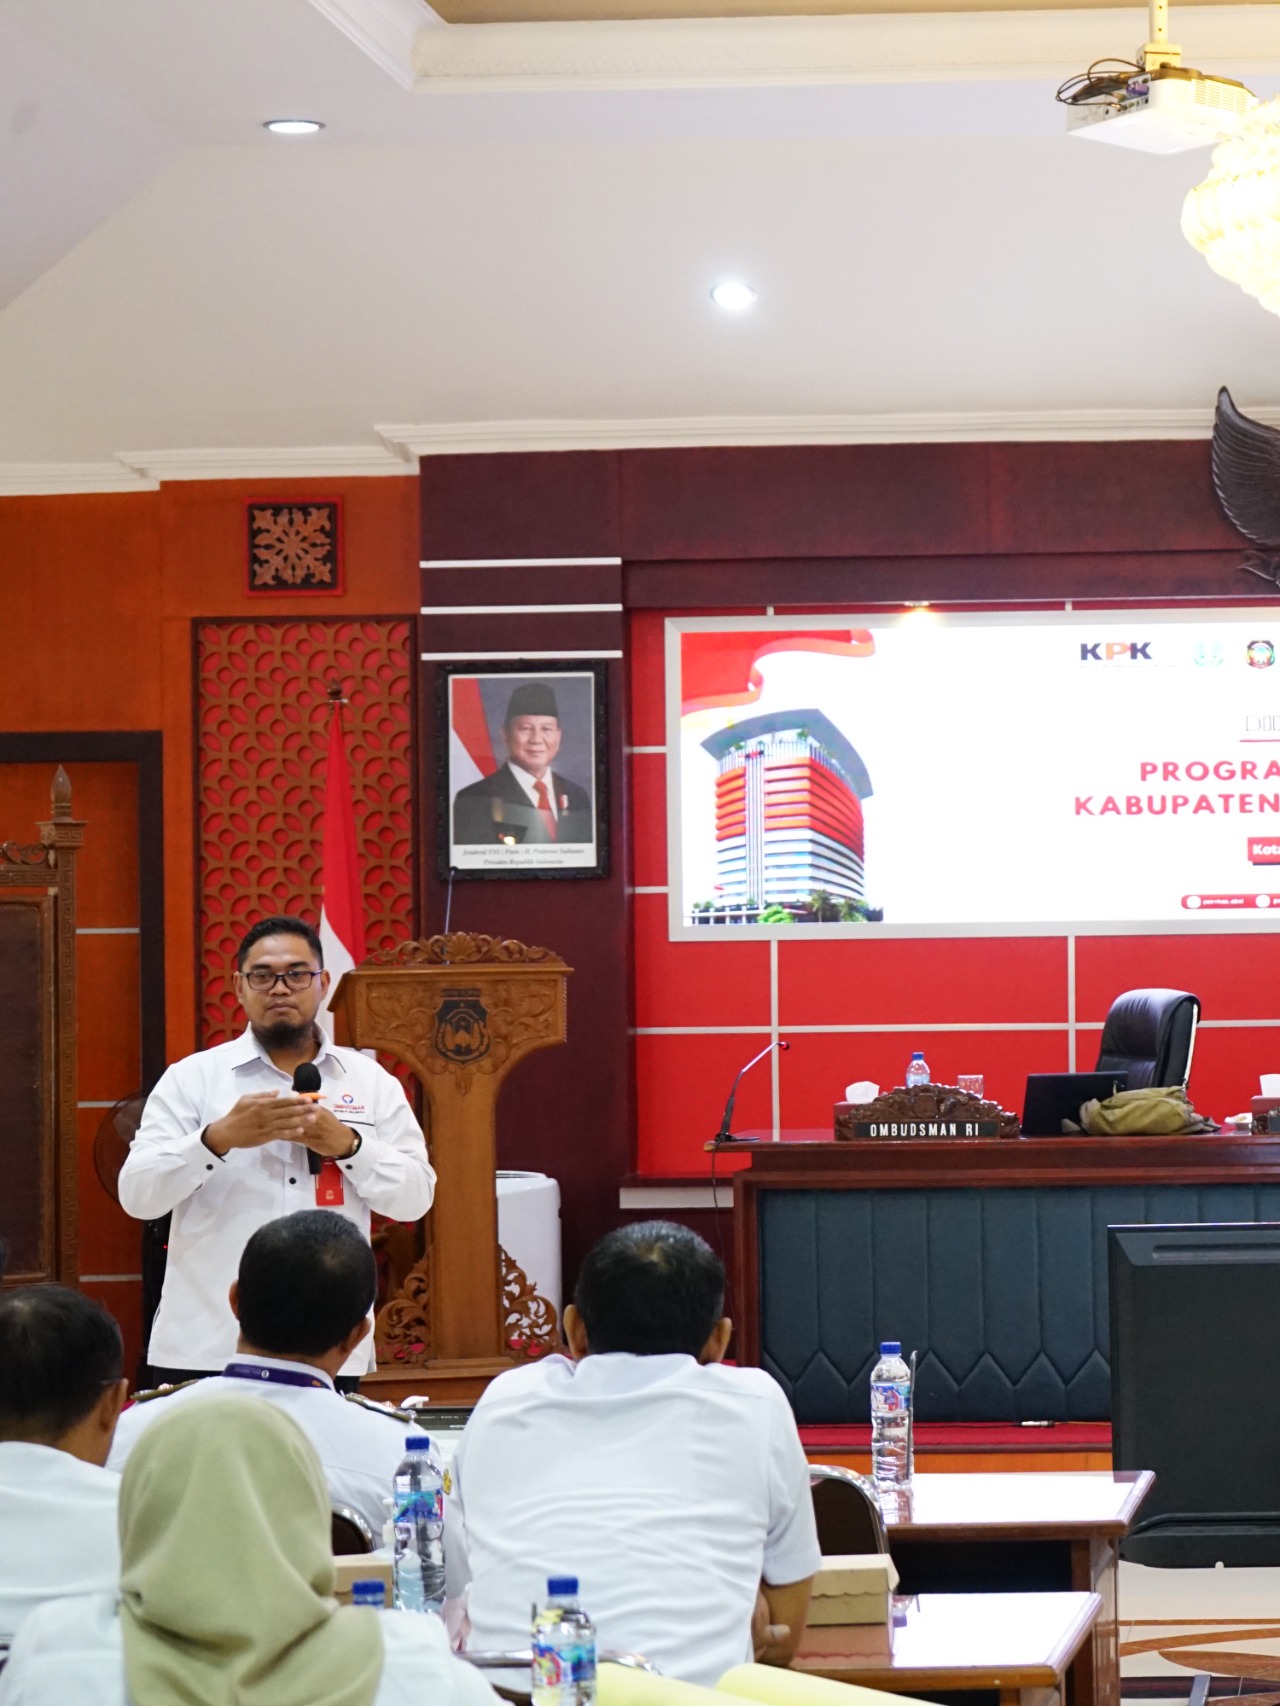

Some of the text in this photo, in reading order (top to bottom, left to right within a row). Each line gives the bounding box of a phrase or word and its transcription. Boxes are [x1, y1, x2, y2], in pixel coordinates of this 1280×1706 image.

[1080, 641, 1153, 661] KPK
[869, 1122, 979, 1137] OMBUDSMAN RI
